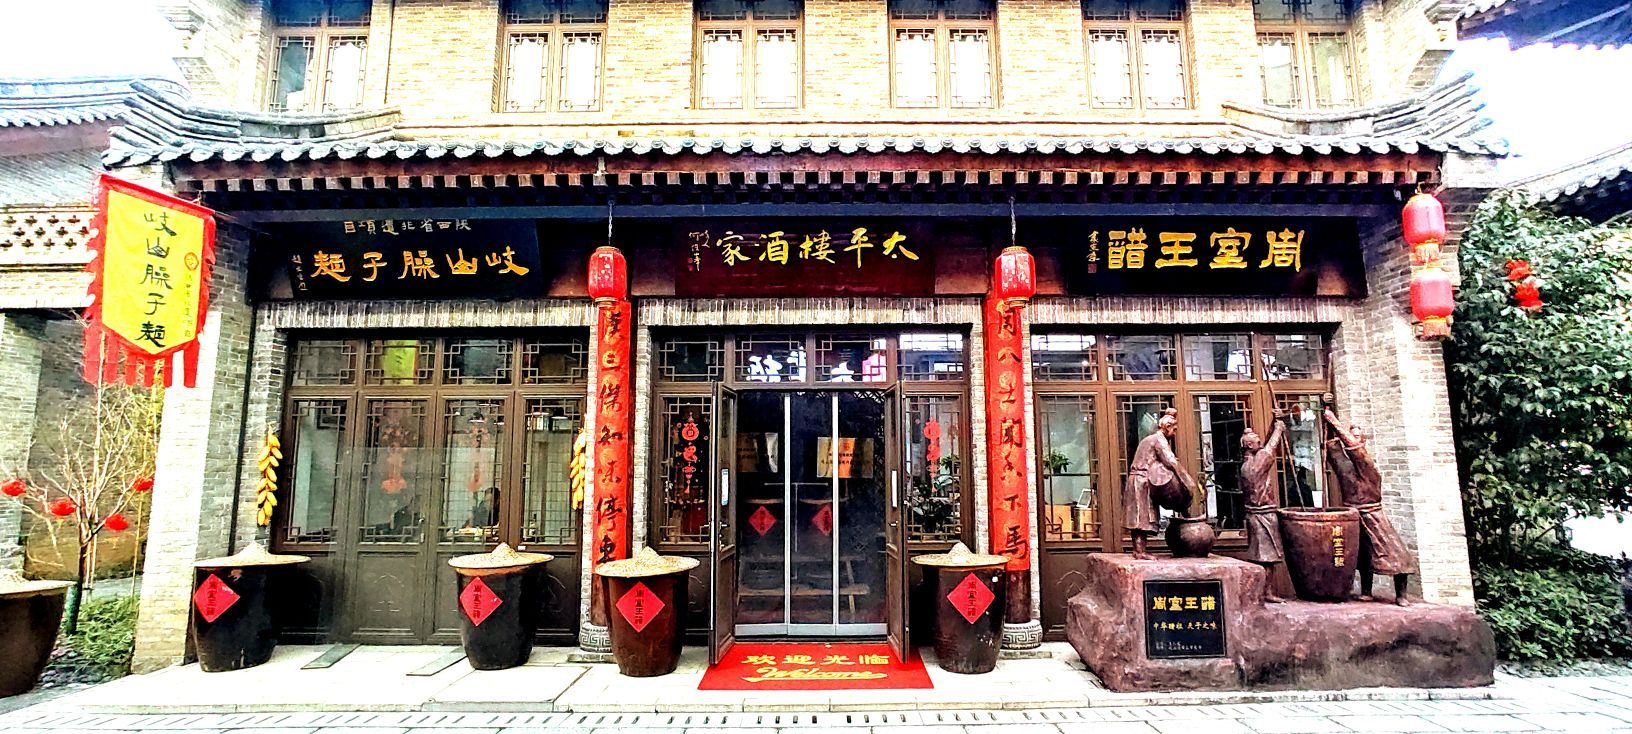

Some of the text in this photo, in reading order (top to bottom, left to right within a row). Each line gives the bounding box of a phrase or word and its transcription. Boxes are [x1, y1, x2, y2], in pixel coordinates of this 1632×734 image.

[741, 654, 891, 665] 欢迎光临
[742, 667, 888, 682] Welcome
